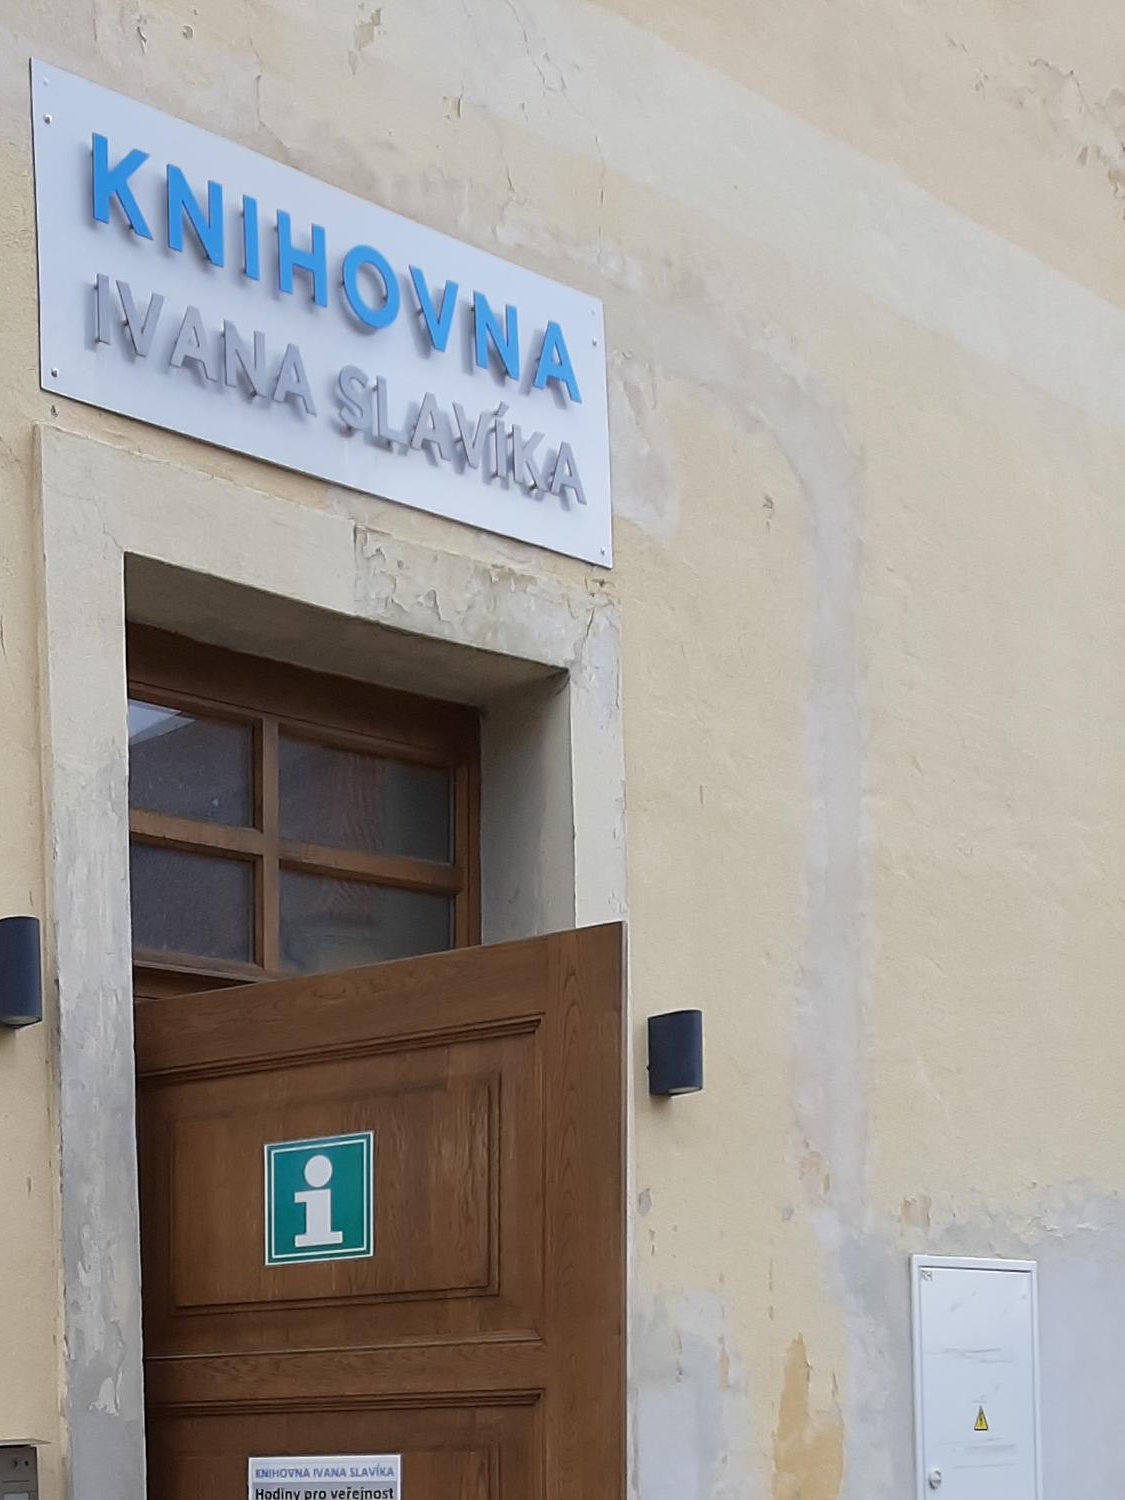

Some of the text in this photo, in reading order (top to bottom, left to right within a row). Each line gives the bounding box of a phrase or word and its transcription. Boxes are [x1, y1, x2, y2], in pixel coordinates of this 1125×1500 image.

[91, 132, 582, 402] KNIHOVNA
[95, 273, 587, 505] IVANA SLAVÍKA
[255, 1464, 394, 1478] KNIHOVNA IVANA SLAVÍKA
